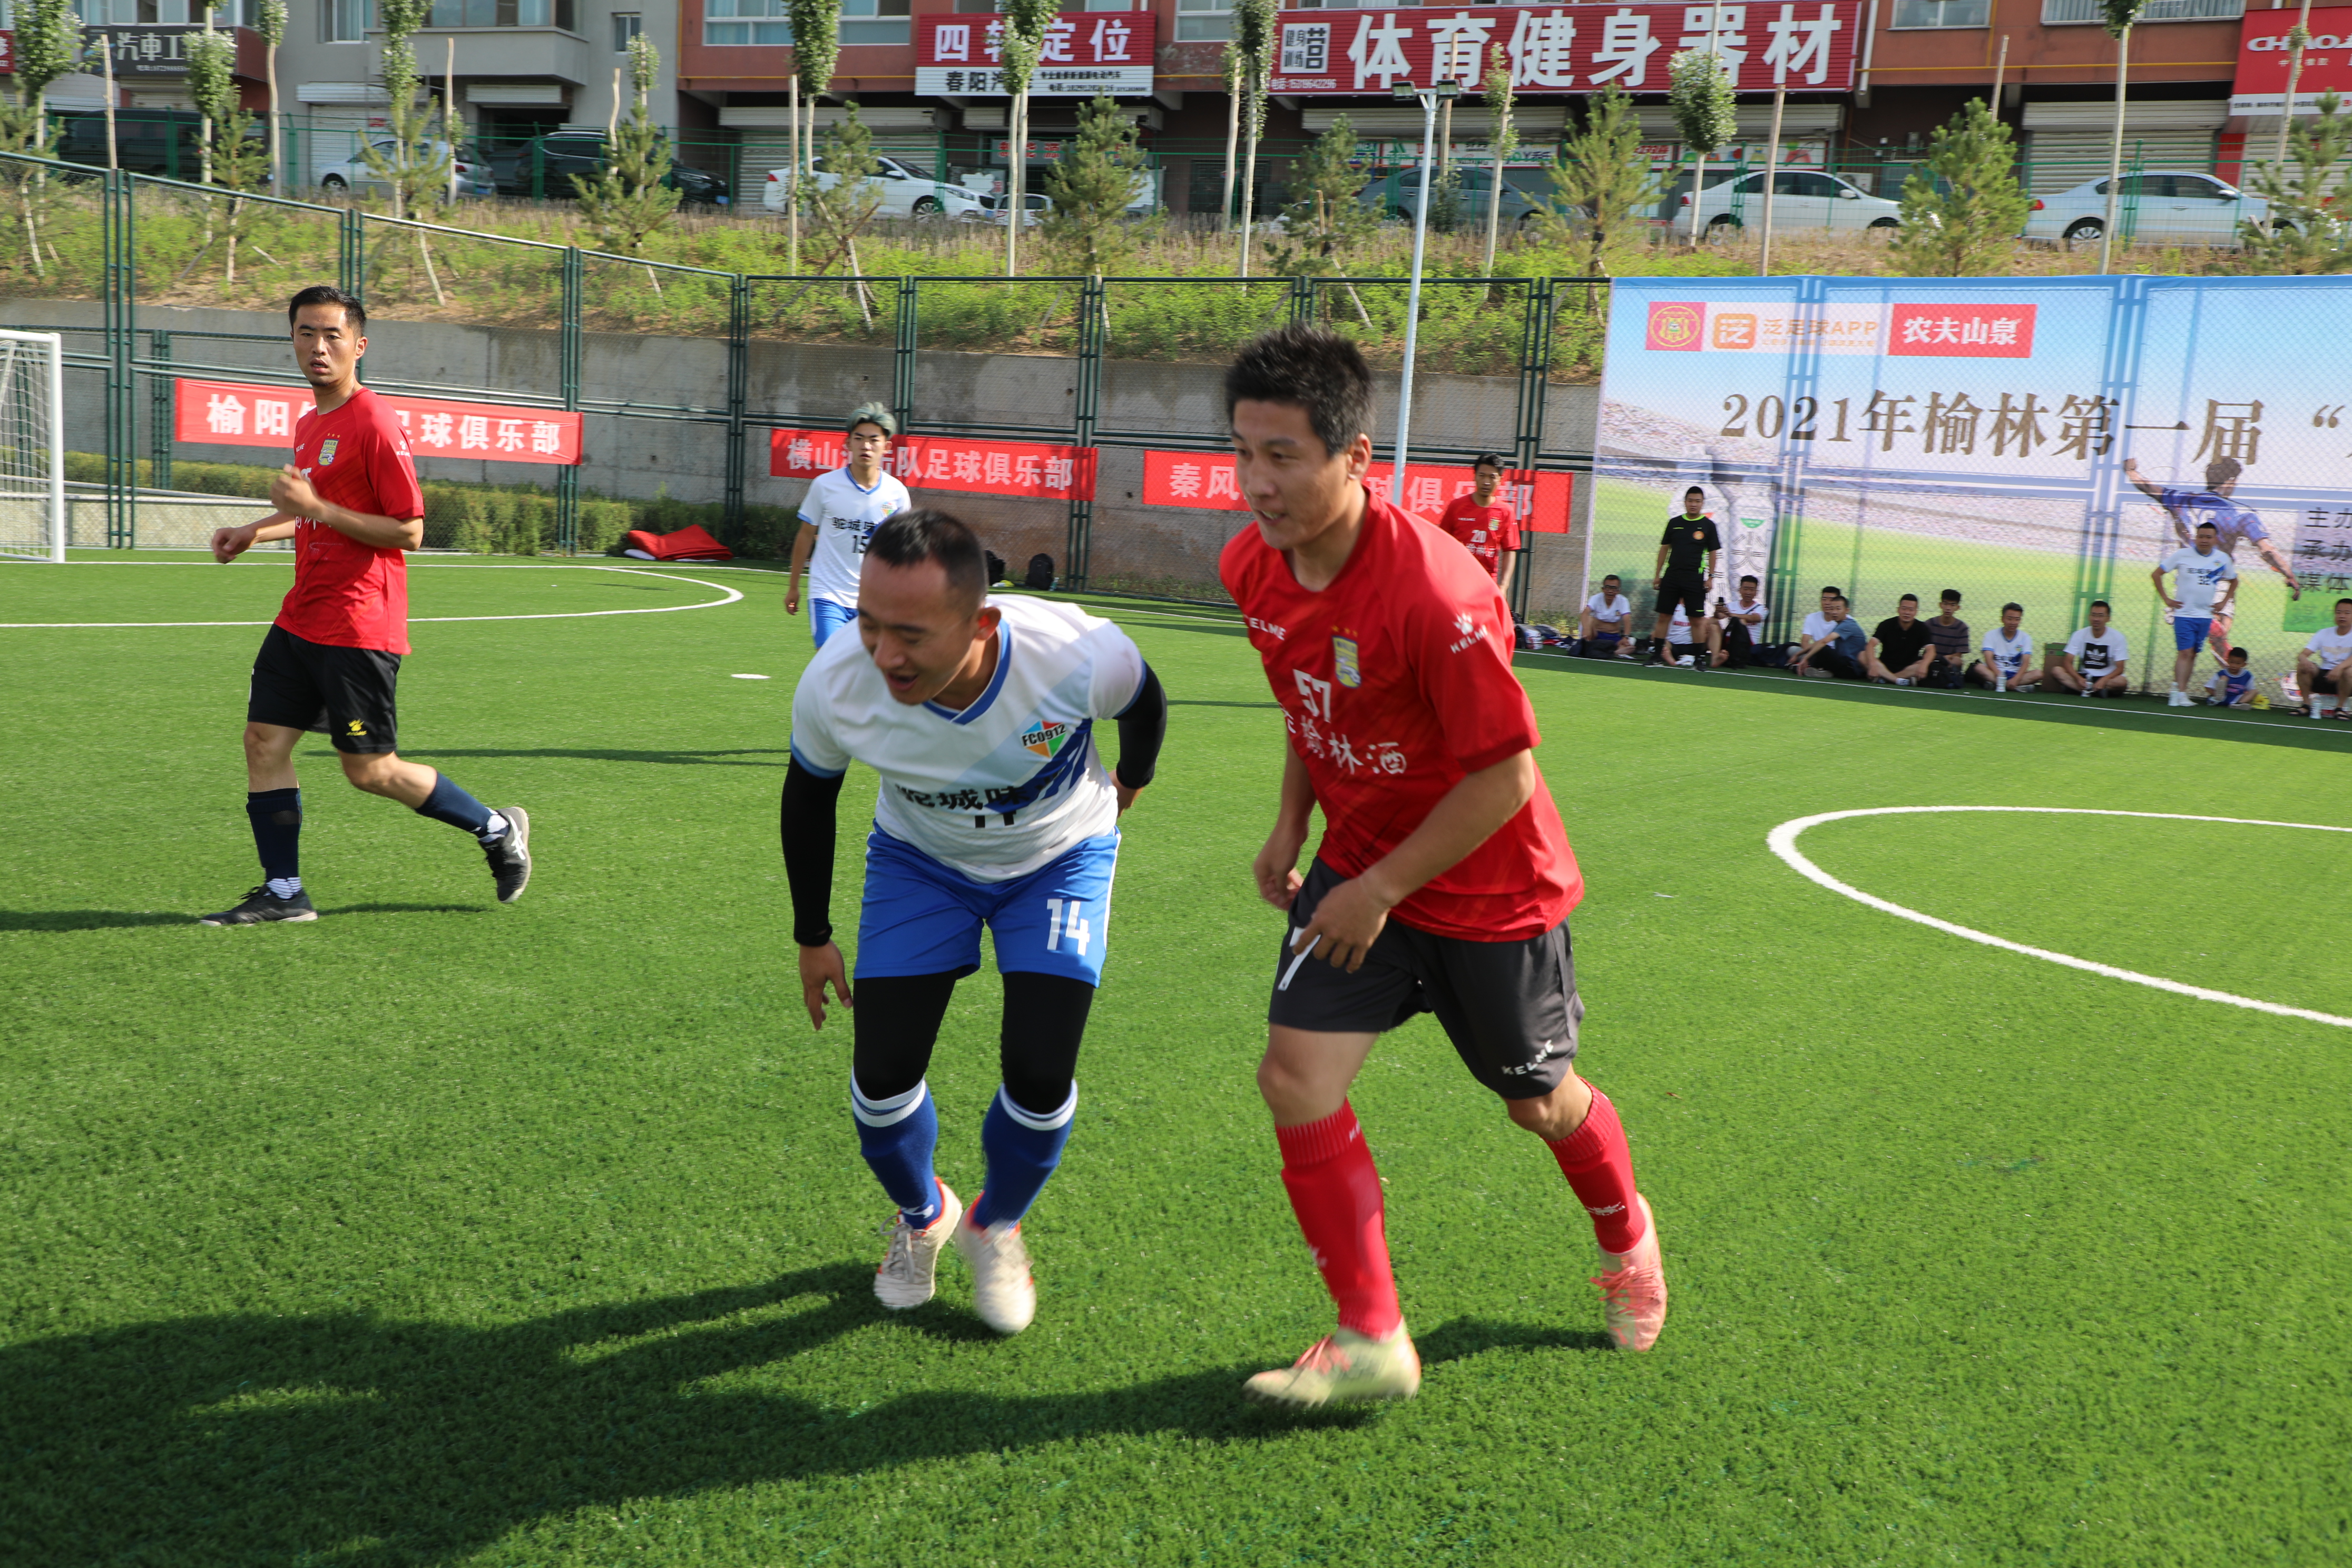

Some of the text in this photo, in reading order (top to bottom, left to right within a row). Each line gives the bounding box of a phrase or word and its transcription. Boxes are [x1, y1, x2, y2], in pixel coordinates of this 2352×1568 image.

[116, 32, 193, 61] 汽車工
[1347, 4, 1841, 89] 体育健身器材
[946, 71, 1032, 92] 春阳汽
[1763, 319, 1879, 336] 泛足球APP
[1902, 317, 2019, 345] 农夫山泉
[1721, 389, 2352, 465] 2021年榆林第一届“
[851, 534, 869, 554] 15
[1471, 530, 1487, 543] 20
[2298, 571, 2351, 594] 媒体
[1243, 613, 1287, 641] ELME
[1449, 624, 1488, 654] KELM
[1293, 669, 1331, 723] 57
[1022, 724, 1067, 746] FC0912
[895, 772, 1058, 810] 驼城味
[1046, 899, 1091, 956] 14
[1501, 1039, 1554, 1075] KELME
